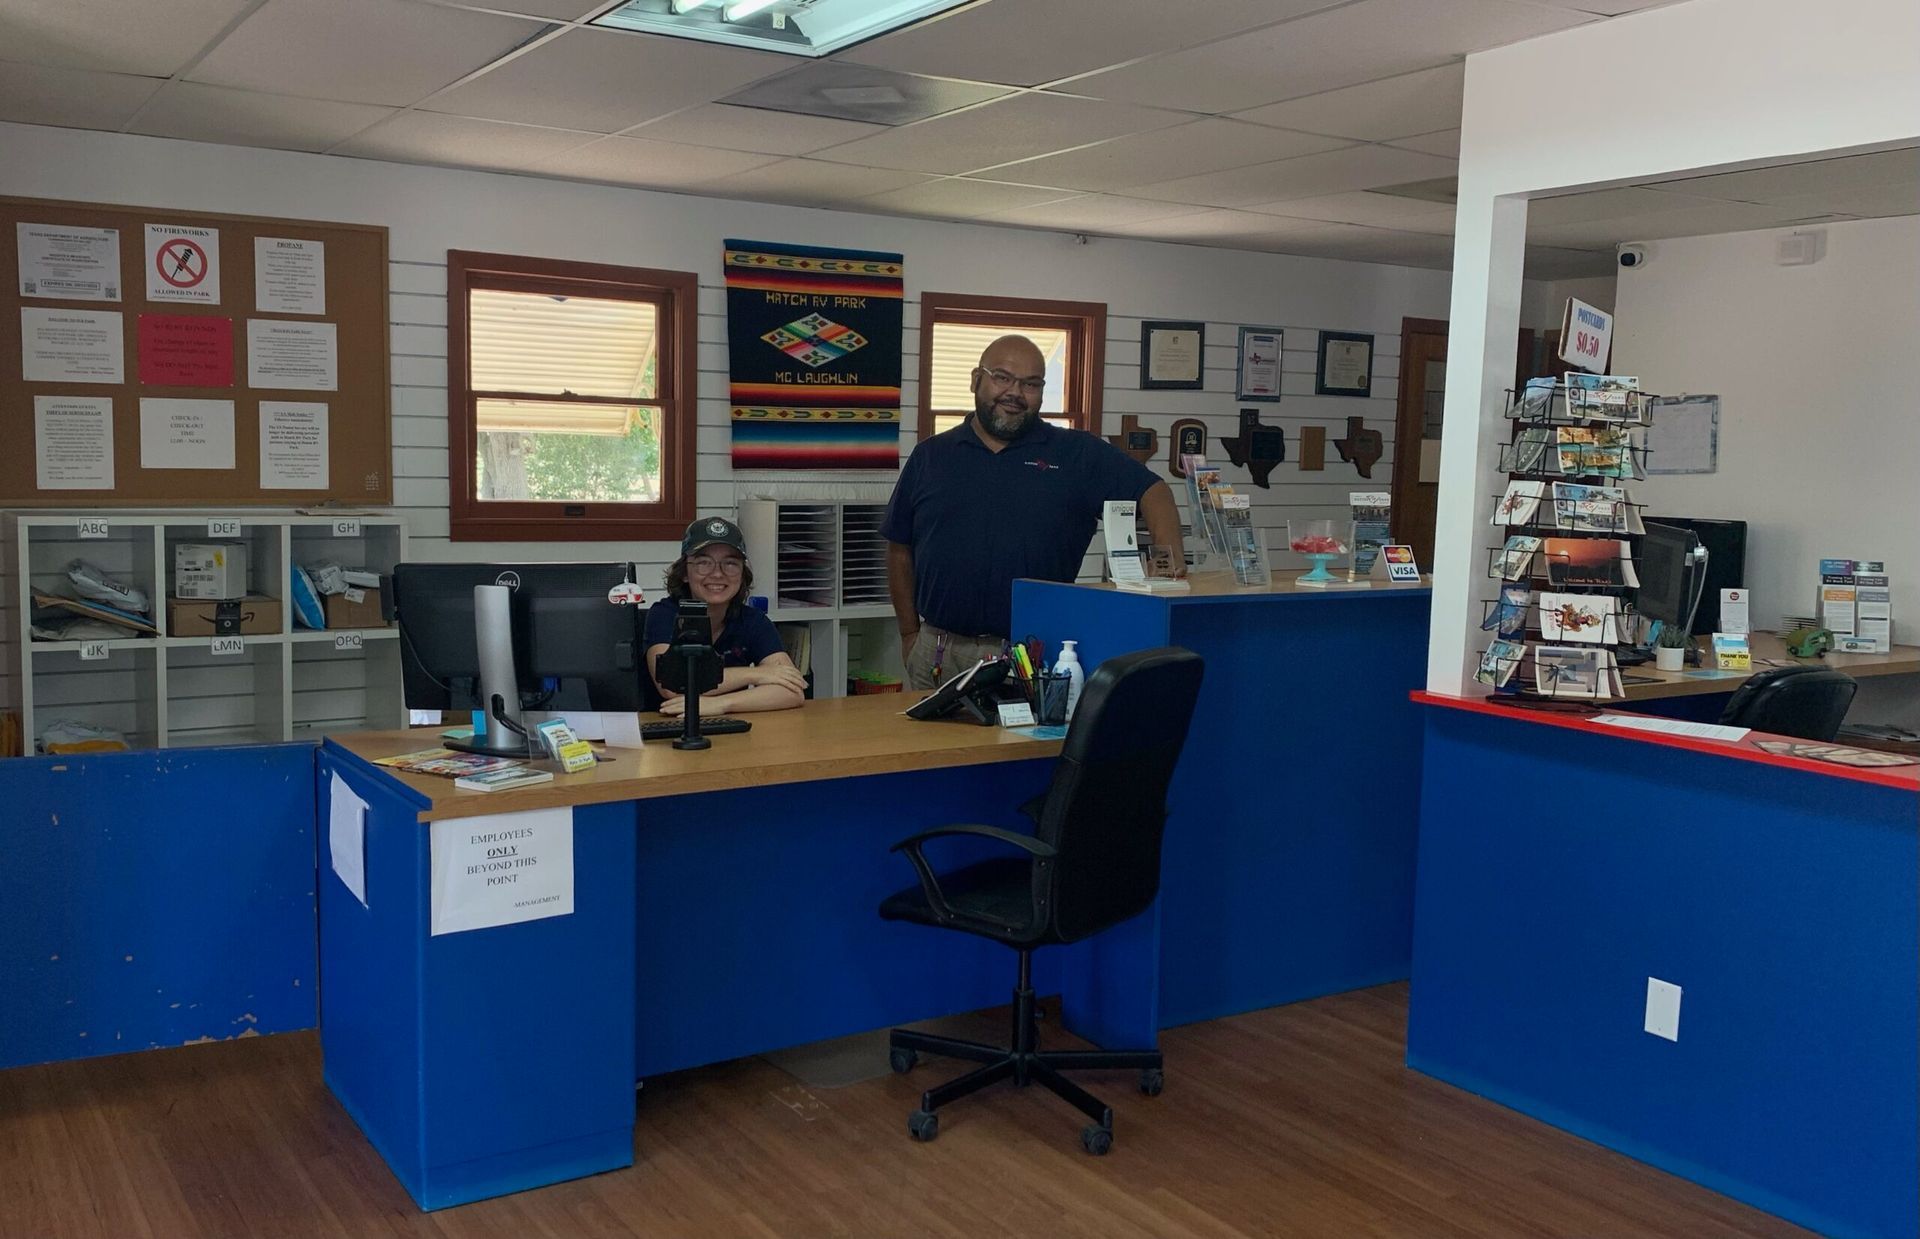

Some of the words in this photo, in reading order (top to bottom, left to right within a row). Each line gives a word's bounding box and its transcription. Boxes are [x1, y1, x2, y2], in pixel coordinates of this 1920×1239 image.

[164, 227, 210, 237] FIREWORKS
[766, 292, 808, 306] HATCH
[812, 294, 828, 308] RV
[834, 296, 866, 309] PARK
[1576, 308, 1606, 332] POSTCARDS
[1576, 330, 1600, 358] $0.50
[796, 372, 858, 384] LAUGHLIN
[82, 522, 107, 534] ABC
[214, 522, 236, 534] DEF
[338, 522, 354, 533] GH
[1393, 566, 1416, 575] VISA
[215, 640, 240, 650] LMN
[336, 635, 362, 646] OPQ
[88, 645, 104, 656] IJK
[470, 828, 534, 845] EMPLOYEES
[487, 845, 518, 858] ONLY
[467, 860, 512, 875] BEYOND
[514, 856, 537, 870] THIS
[486, 874, 518, 886] POINT
